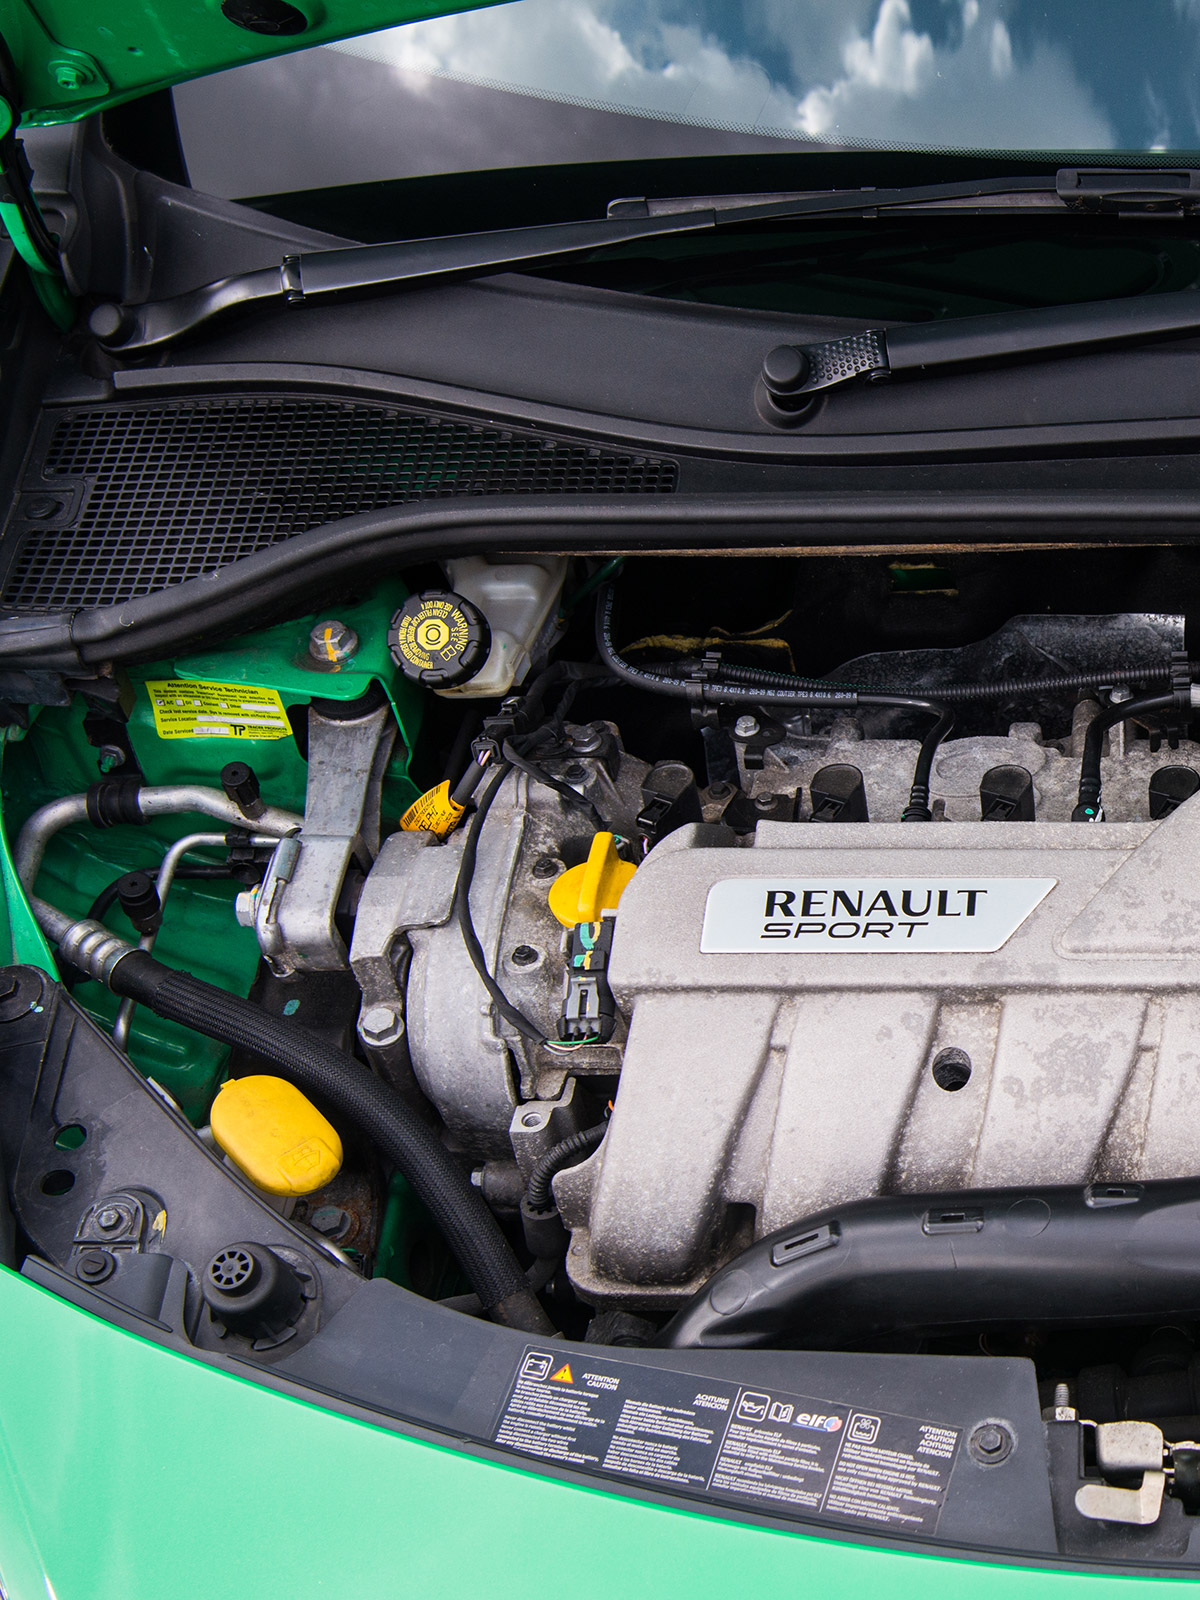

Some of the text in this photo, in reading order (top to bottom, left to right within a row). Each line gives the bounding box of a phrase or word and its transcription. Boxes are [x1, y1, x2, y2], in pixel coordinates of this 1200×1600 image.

[433, 609, 448, 618] CLEAN
[411, 616, 420, 627] CAP
[407, 625, 415, 643] BEFORE
[451, 608, 468, 652] WARNING
[199, 684, 222, 692] Service
[224, 687, 258, 695] Technician
[764, 890, 988, 917] RENAULT
[760, 922, 928, 938] SPORT
[582, 1373, 619, 1383] ATTENTION
[587, 1380, 617, 1390] CAUTION
[696, 1394, 729, 1404] ACHTUNG
[693, 1400, 727, 1410] ATENCION
[796, 1413, 826, 1427] elf
[919, 1426, 957, 1437] ATTENTION
[925, 1433, 955, 1444] CAUTION
[920, 1439, 953, 1451] ACHTUNG
[917, 1446, 951, 1457] ATENCION
